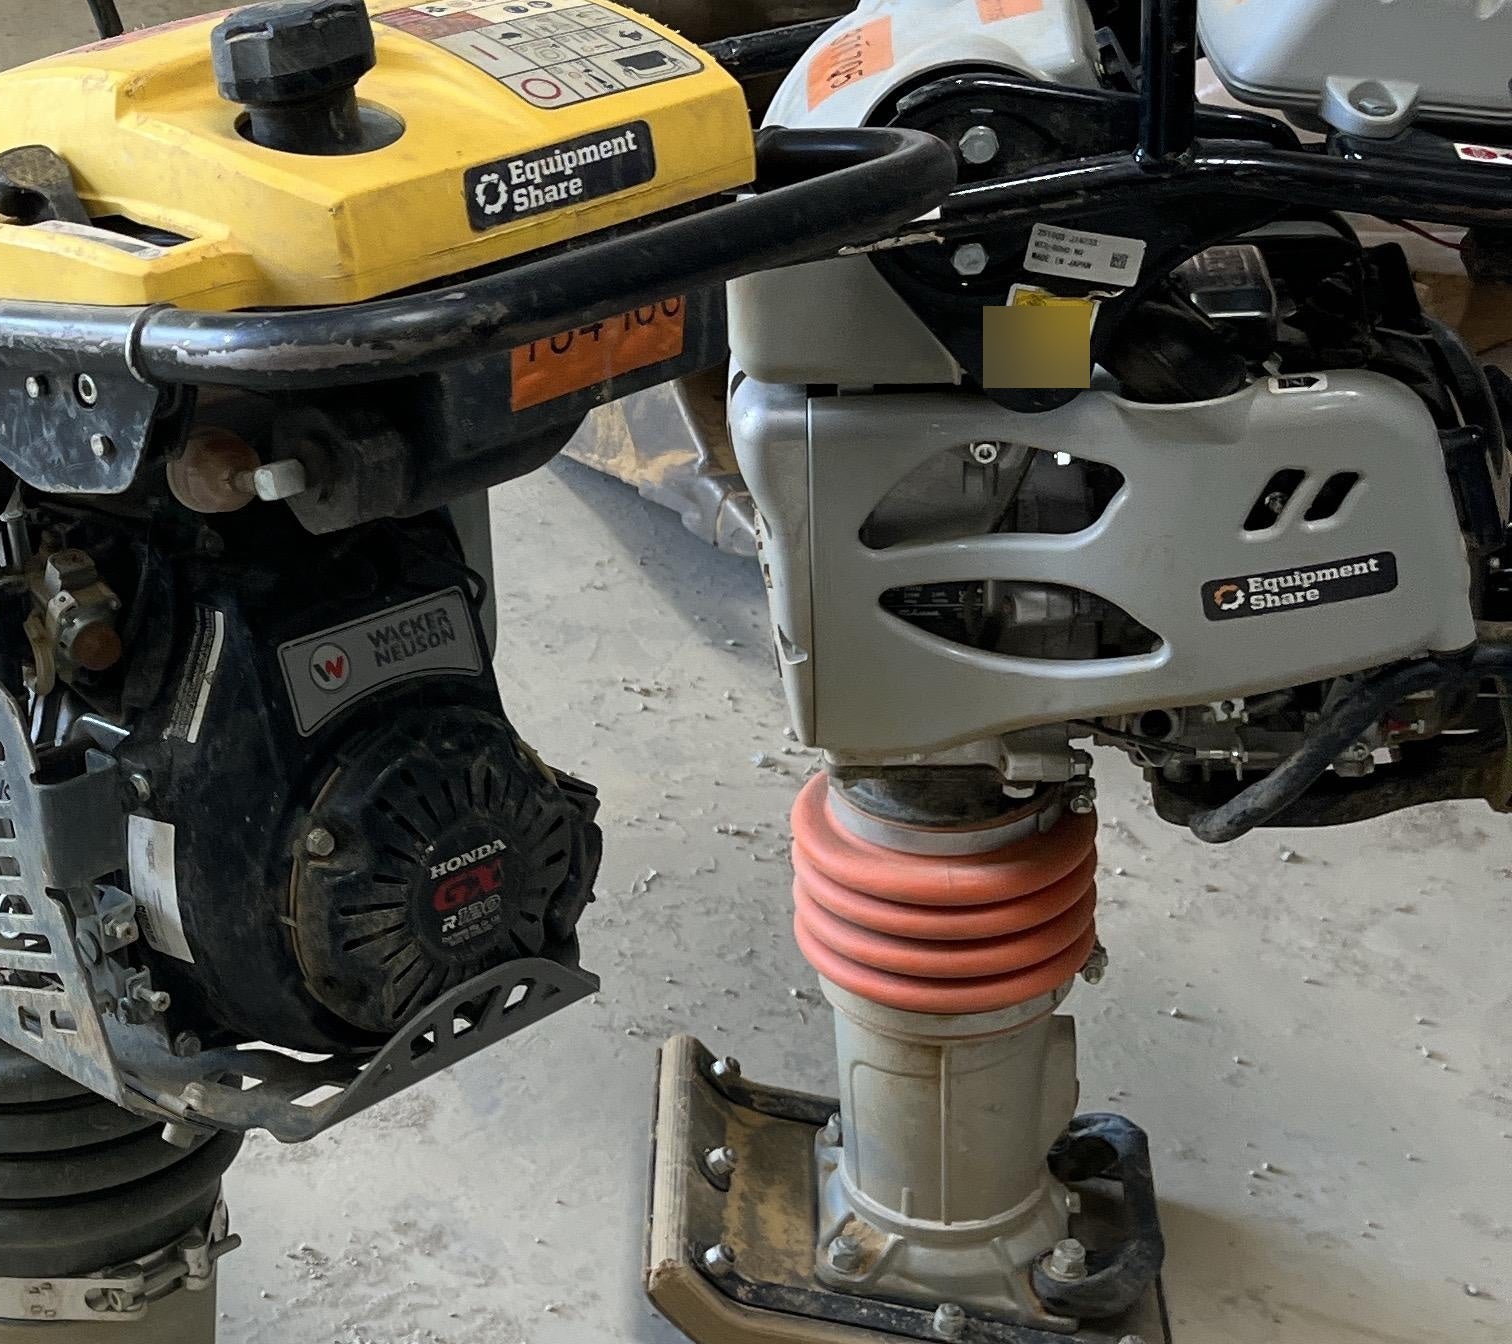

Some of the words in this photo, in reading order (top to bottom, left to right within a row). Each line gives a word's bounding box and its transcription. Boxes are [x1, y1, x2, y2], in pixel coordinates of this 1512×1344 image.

[507, 130, 638, 185] Equipment
[512, 177, 583, 212] Share
[1247, 558, 1379, 593] Equipment
[1250, 588, 1321, 610] Share
[366, 608, 448, 647] WACKER
[373, 623, 456, 667] NEUSON
[430, 839, 507, 880] HONDA
